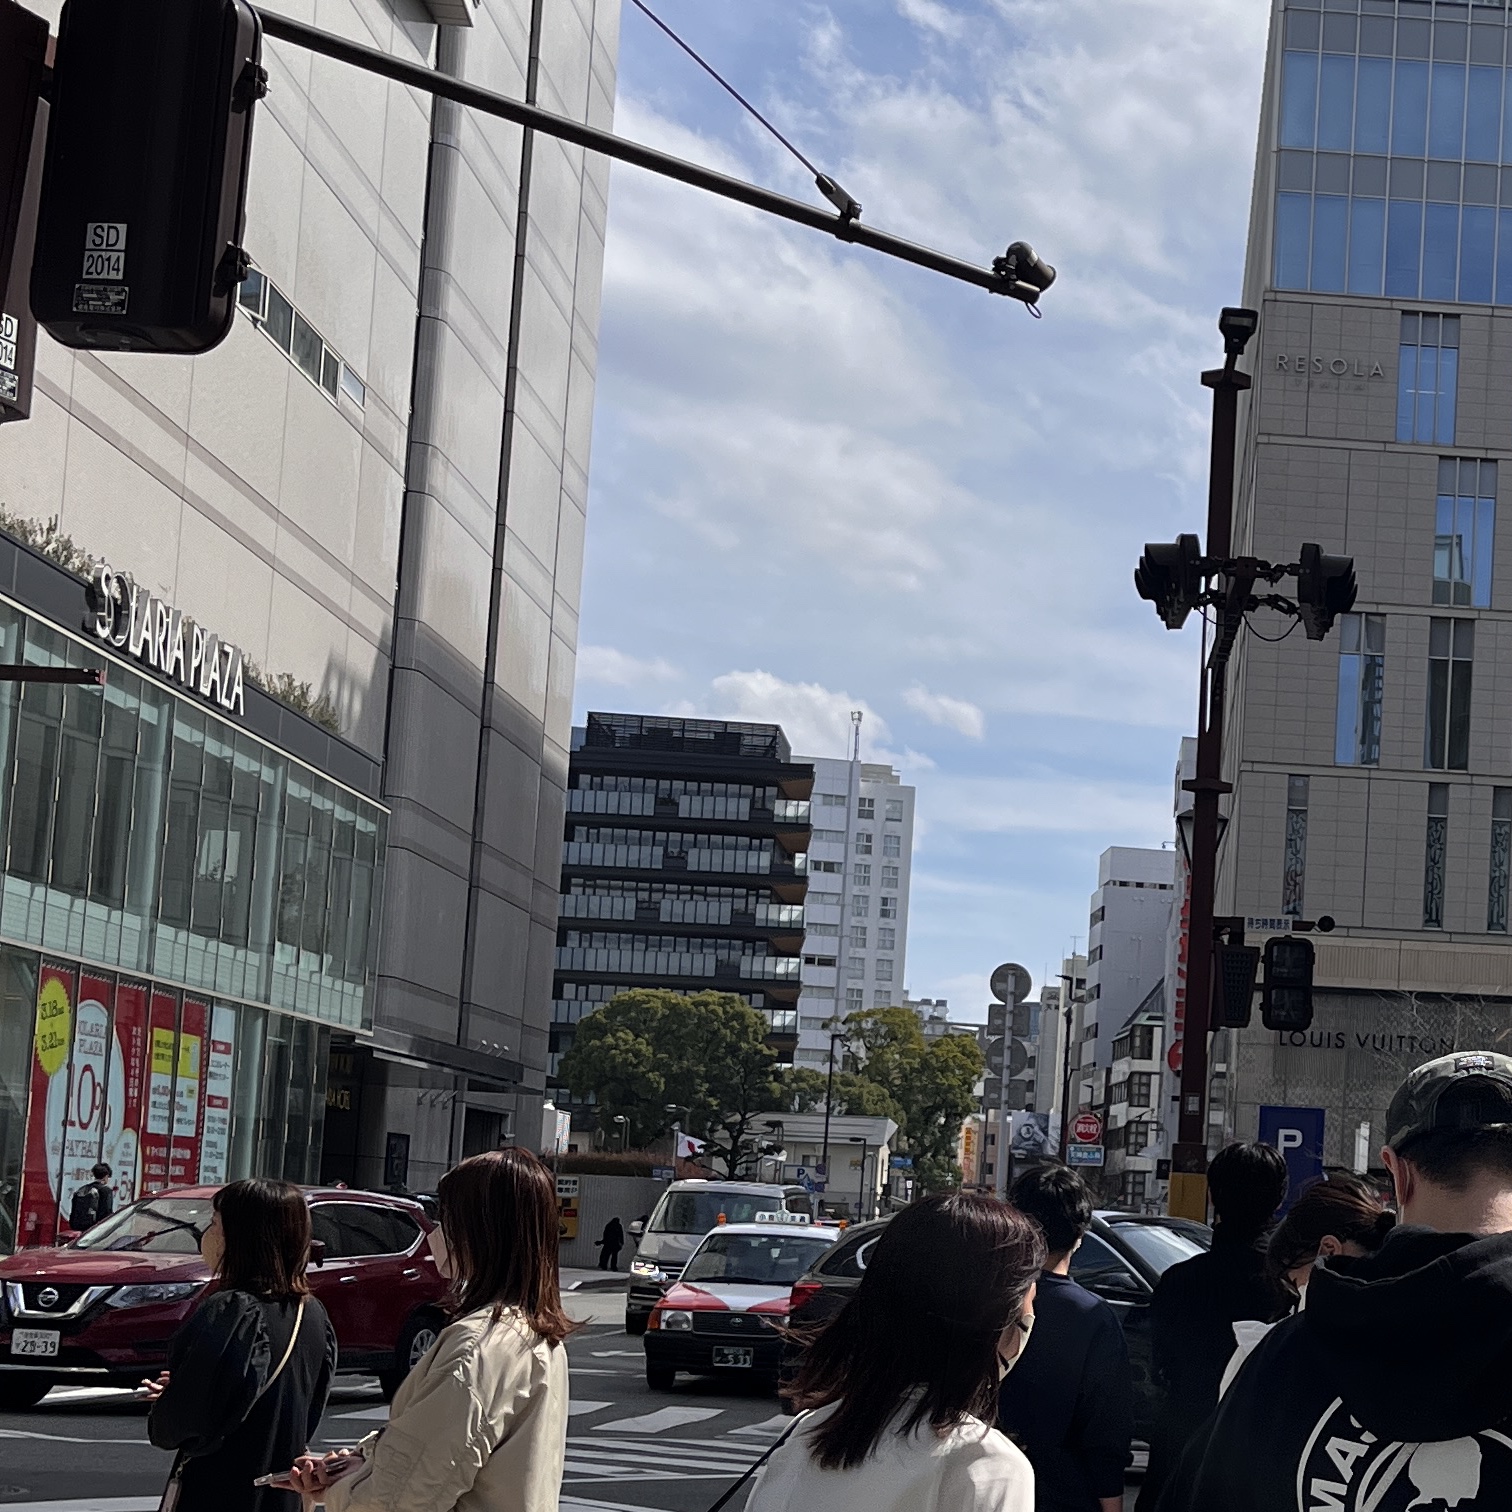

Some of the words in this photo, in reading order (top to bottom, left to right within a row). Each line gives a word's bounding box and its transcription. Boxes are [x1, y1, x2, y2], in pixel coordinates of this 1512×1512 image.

[91, 224, 120, 248] SD
[85, 253, 121, 277] 2014
[1275, 353, 1384, 377] RESOLA
[93, 563, 186, 684] SOLARIA
[189, 622, 245, 717] PLAZA
[1280, 1030, 1346, 1049] LOUIS
[1355, 1032, 1456, 1054] VUITTON
[1277, 1128, 1303, 1157] P
